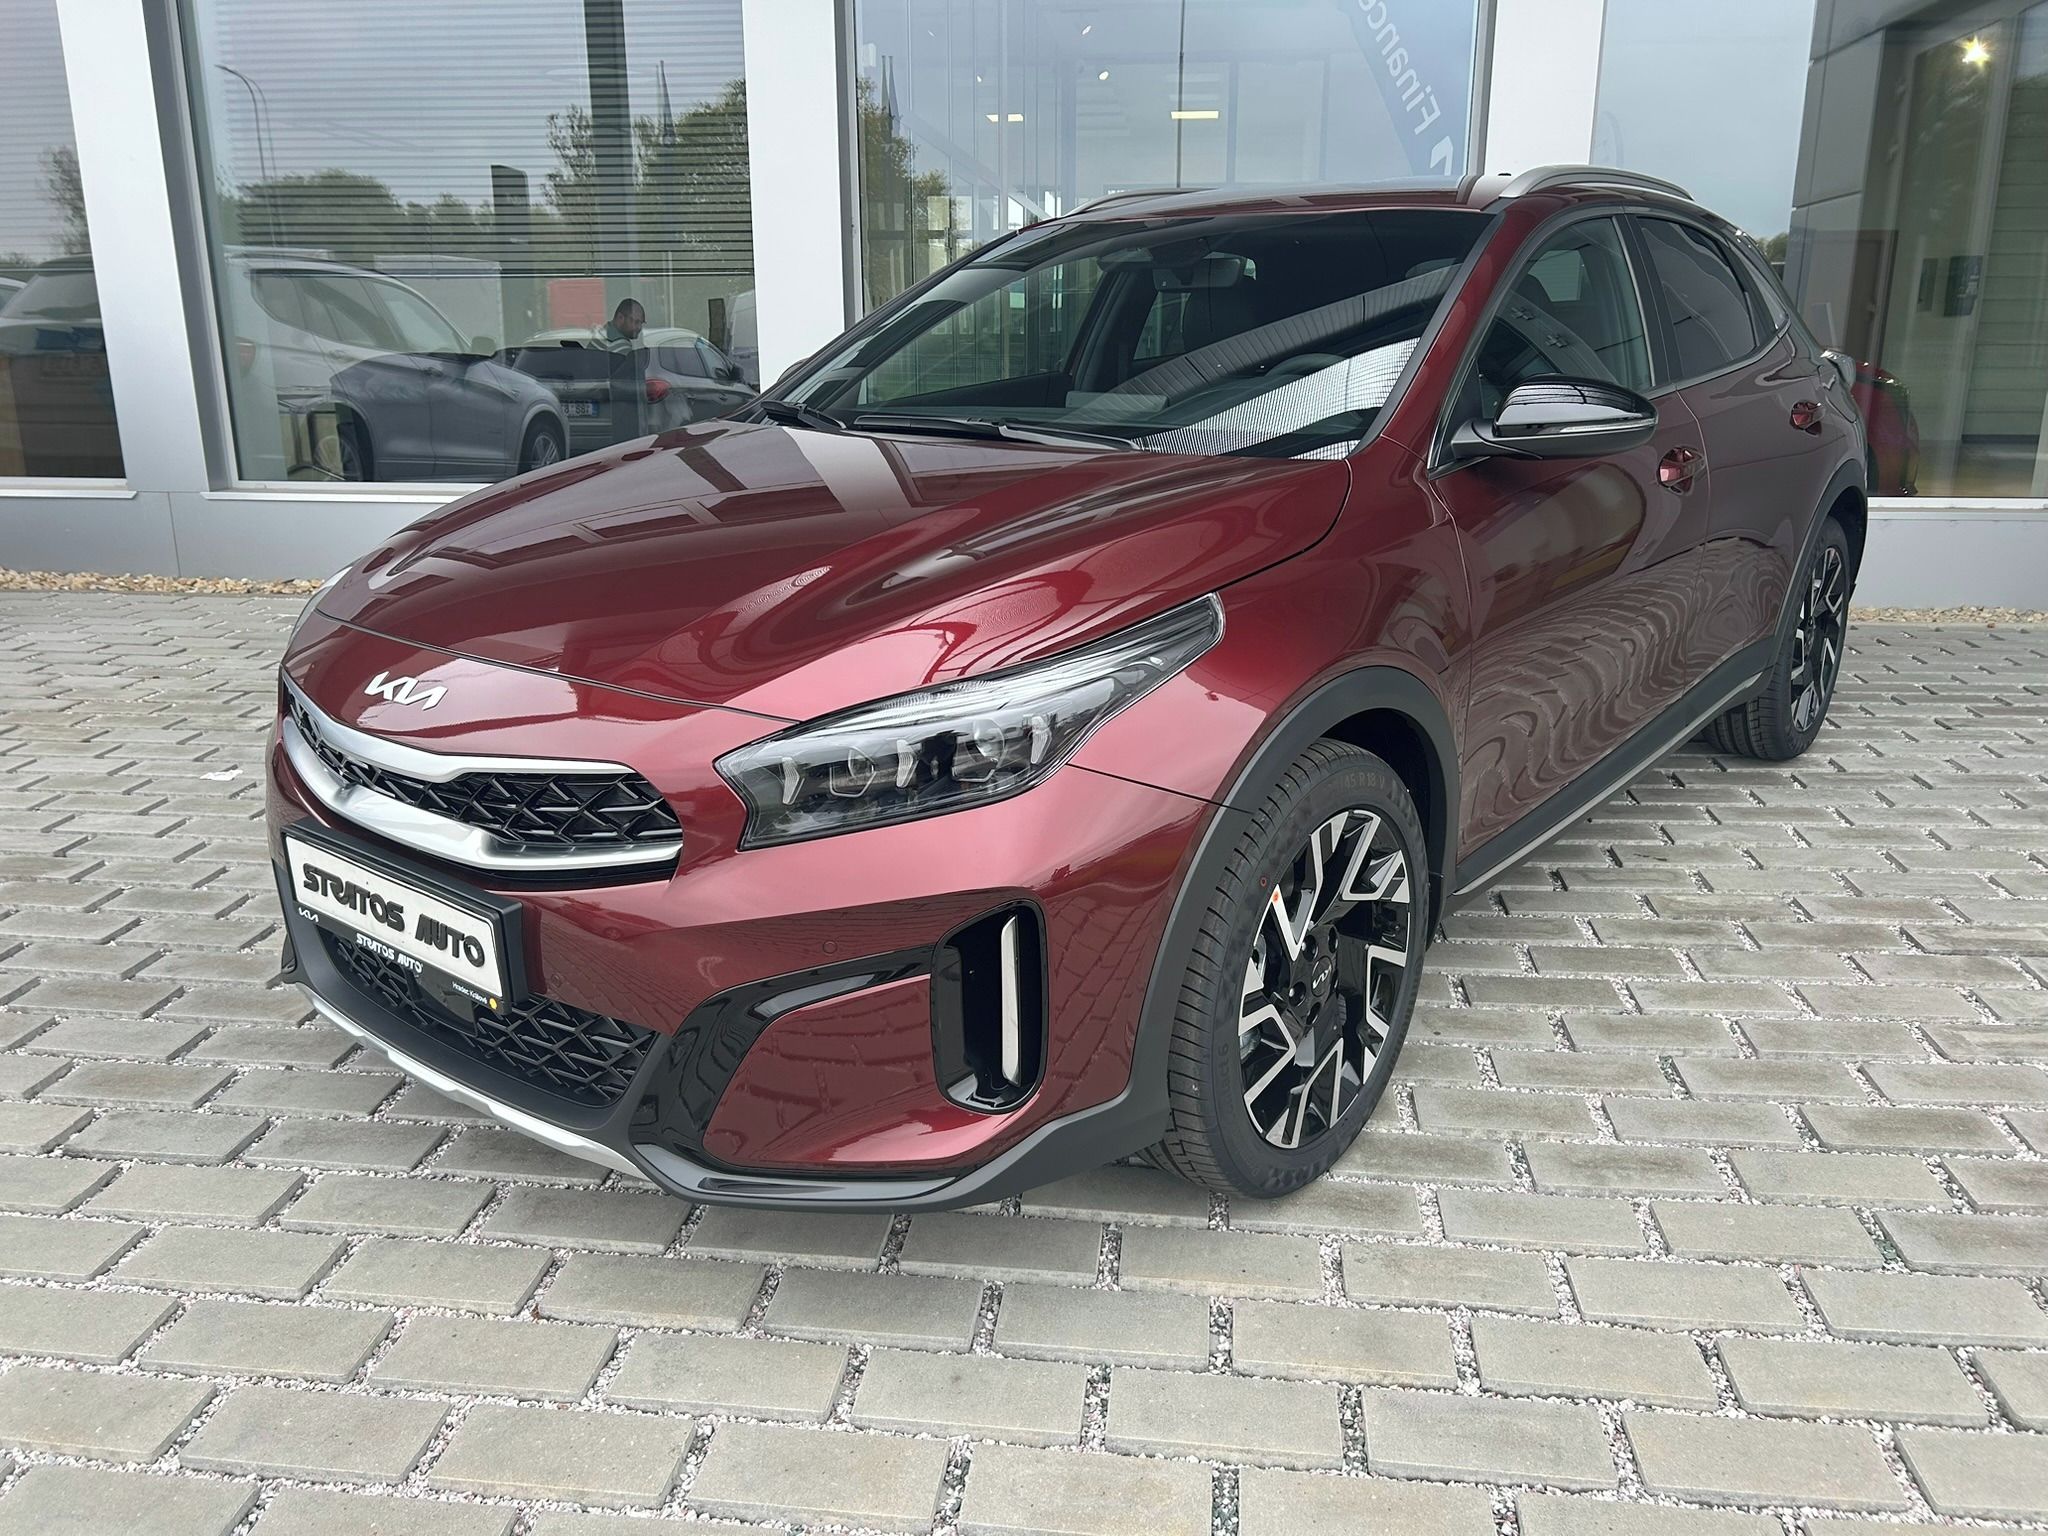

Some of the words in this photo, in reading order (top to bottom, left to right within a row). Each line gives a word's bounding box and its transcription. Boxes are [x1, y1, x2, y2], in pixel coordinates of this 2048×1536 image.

[303, 863, 405, 932] STRATOS
[415, 914, 485, 968] AUTO
[356, 933, 395, 960] STRATOS
[397, 953, 423, 974] AUTO
